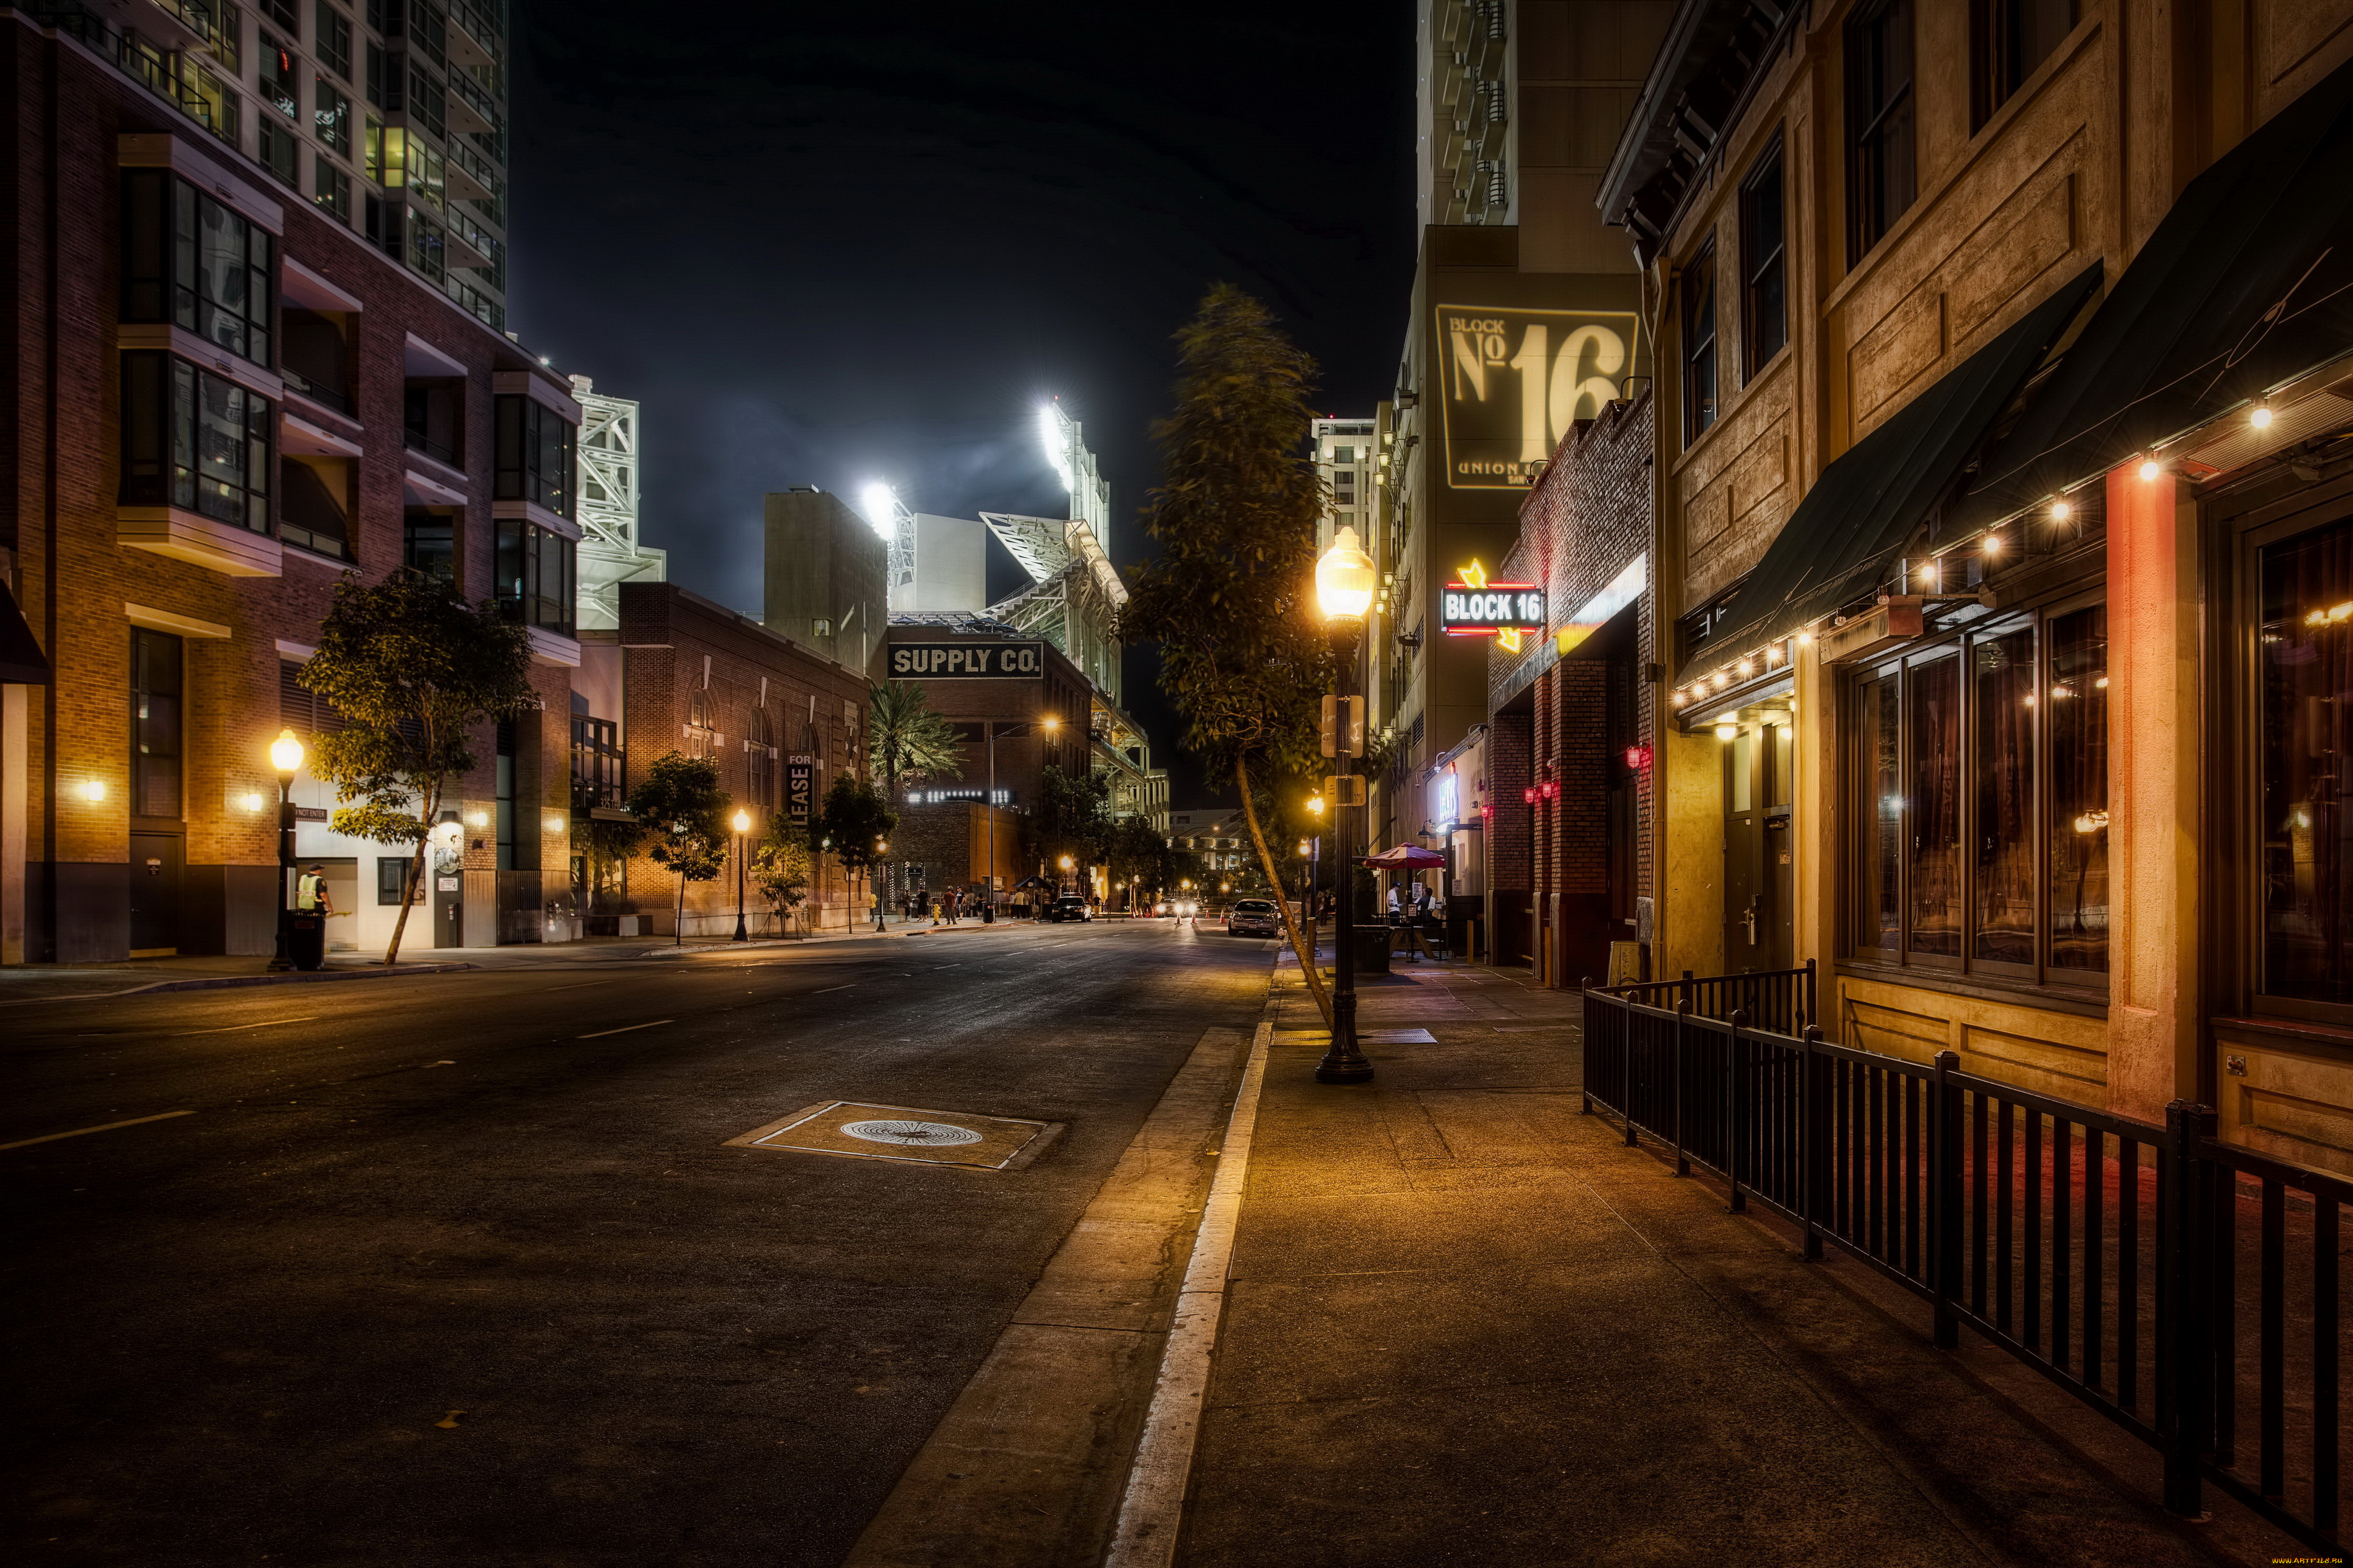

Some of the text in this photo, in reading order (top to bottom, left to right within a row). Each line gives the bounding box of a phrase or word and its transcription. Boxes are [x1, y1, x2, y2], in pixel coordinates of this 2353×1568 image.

[1450, 318, 1505, 334] BLOCK
[1510, 324, 1625, 463] 16
[1458, 462, 1518, 475] UNION
[1446, 594, 1540, 620] BLOCK 16
[894, 649, 1040, 672] SUPPLY CO.
[789, 755, 811, 764] FOR
[791, 768, 808, 826] LEASE
